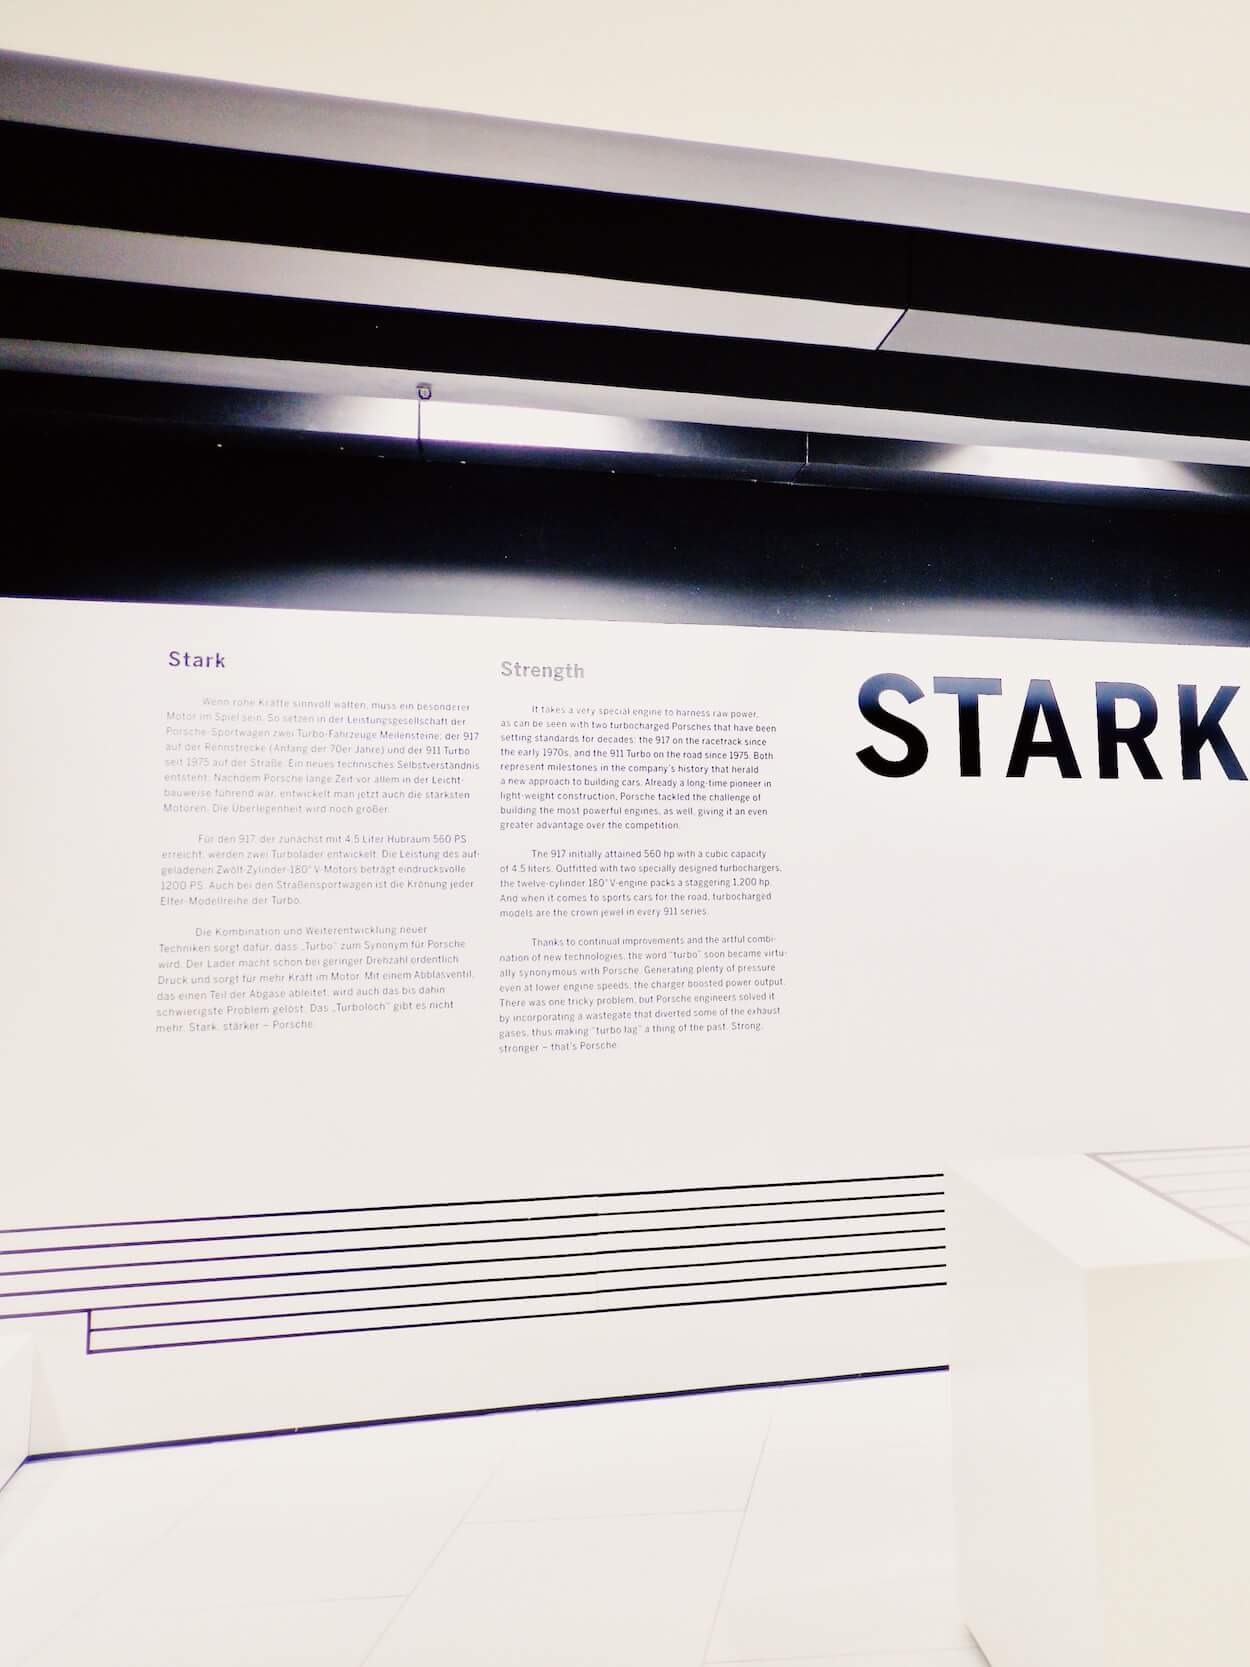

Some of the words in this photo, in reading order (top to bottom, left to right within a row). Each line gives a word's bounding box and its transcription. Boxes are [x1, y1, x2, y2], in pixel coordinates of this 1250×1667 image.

[168, 651, 226, 668] Stark
[500, 661, 585, 682] Strength
[513, 720, 530, 728] can
[532, 718, 543, 728] be
[569, 719, 589, 729] with
[591, 719, 608, 729] two
[610, 720, 670, 732] turbocharged
[672, 721, 712, 731] Porsches
[713, 722, 731, 732] that
[733, 723, 754, 732] have
[755, 723, 777, 733] been
[855, 672, 1249, 781] STARK
[500, 732, 532, 744] setting
[534, 733, 580, 742] standards
[582, 734, 594, 743] for
[638, 735, 653, 744] the
[654, 735, 670, 744] 917
[672, 737, 683, 745] on
[685, 736, 700, 745] the
[701, 736, 743, 746] racetrack
[744, 737, 767, 746] since
[500, 761, 546, 773] represent
[546, 762, 598, 772] milestones
[600, 763, 609, 772] in
[611, 763, 626, 772] the
[677, 764, 709, 775] history
[711, 764, 729, 773] that
[731, 764, 759, 774] herald
[528, 776, 570, 788] approach
[572, 777, 582, 786] to
[584, 777, 620, 789] building
[644, 777, 677, 789] Already
[686, 778, 728, 790] long-time
[729, 778, 761, 790] pioneer
[763, 778, 772, 788] in
[620, 791, 655, 801] Porsche
[658, 792, 690, 801] tackled
[692, 792, 707, 801] the
[708, 792, 751, 804] challenge
[752, 792, 761, 802] of
[499, 819, 533, 831] greater
[536, 820, 584, 831] advantage
[608, 820, 623, 829] the
[532, 849, 548, 858] The
[550, 849, 566, 858] 917
[568, 849, 602, 861] initially
[604, 849, 642, 858] attained
[643, 849, 662, 858] 560
[663, 849, 675, 860] hp
[676, 849, 696, 858] with
[705, 849, 728, 858] cubic
[730, 849, 767, 860] capacity
[499, 893, 518, 902] And
[520, 893, 545, 902] when
[547, 893, 554, 902] it
[589, 893, 600, 902] to
[602, 892, 631, 904] sports
[633, 894, 653, 902] cars
[655, 892, 667, 901] for
[670, 892, 685, 901] the
[712, 891, 772, 903] turbocharged
[530, 937, 564, 947] Thanks
[566, 937, 576, 946] to
[577, 936, 620, 946] continual
[622, 936, 685, 947] improvements
[686, 935, 703, 944] and
[705, 935, 719, 944] the
[721, 934, 745, 944] artful
[500, 998, 526, 1007] There
[528, 999, 546, 1007] was
[567, 996, 594, 1008] tricky
[638, 994, 654, 1004] but
[656, 994, 692, 1003] Porsche
[693, 993, 737, 1004] engineers
[738, 992, 767, 1001] solved
[768, 991, 775, 1001] it
[498, 1013, 510, 1025] by
[512, 1012, 575, 1024] incorporating
[584, 1010, 632, 1022] wastegate
[634, 1009, 652, 1019] that
[654, 1008, 692, 1018] diverted
[693, 1009, 717, 1017] some
[719, 1007, 728, 1016] of
[730, 1006, 745, 1016] the
[746, 1006, 780, 1015] exhaust
